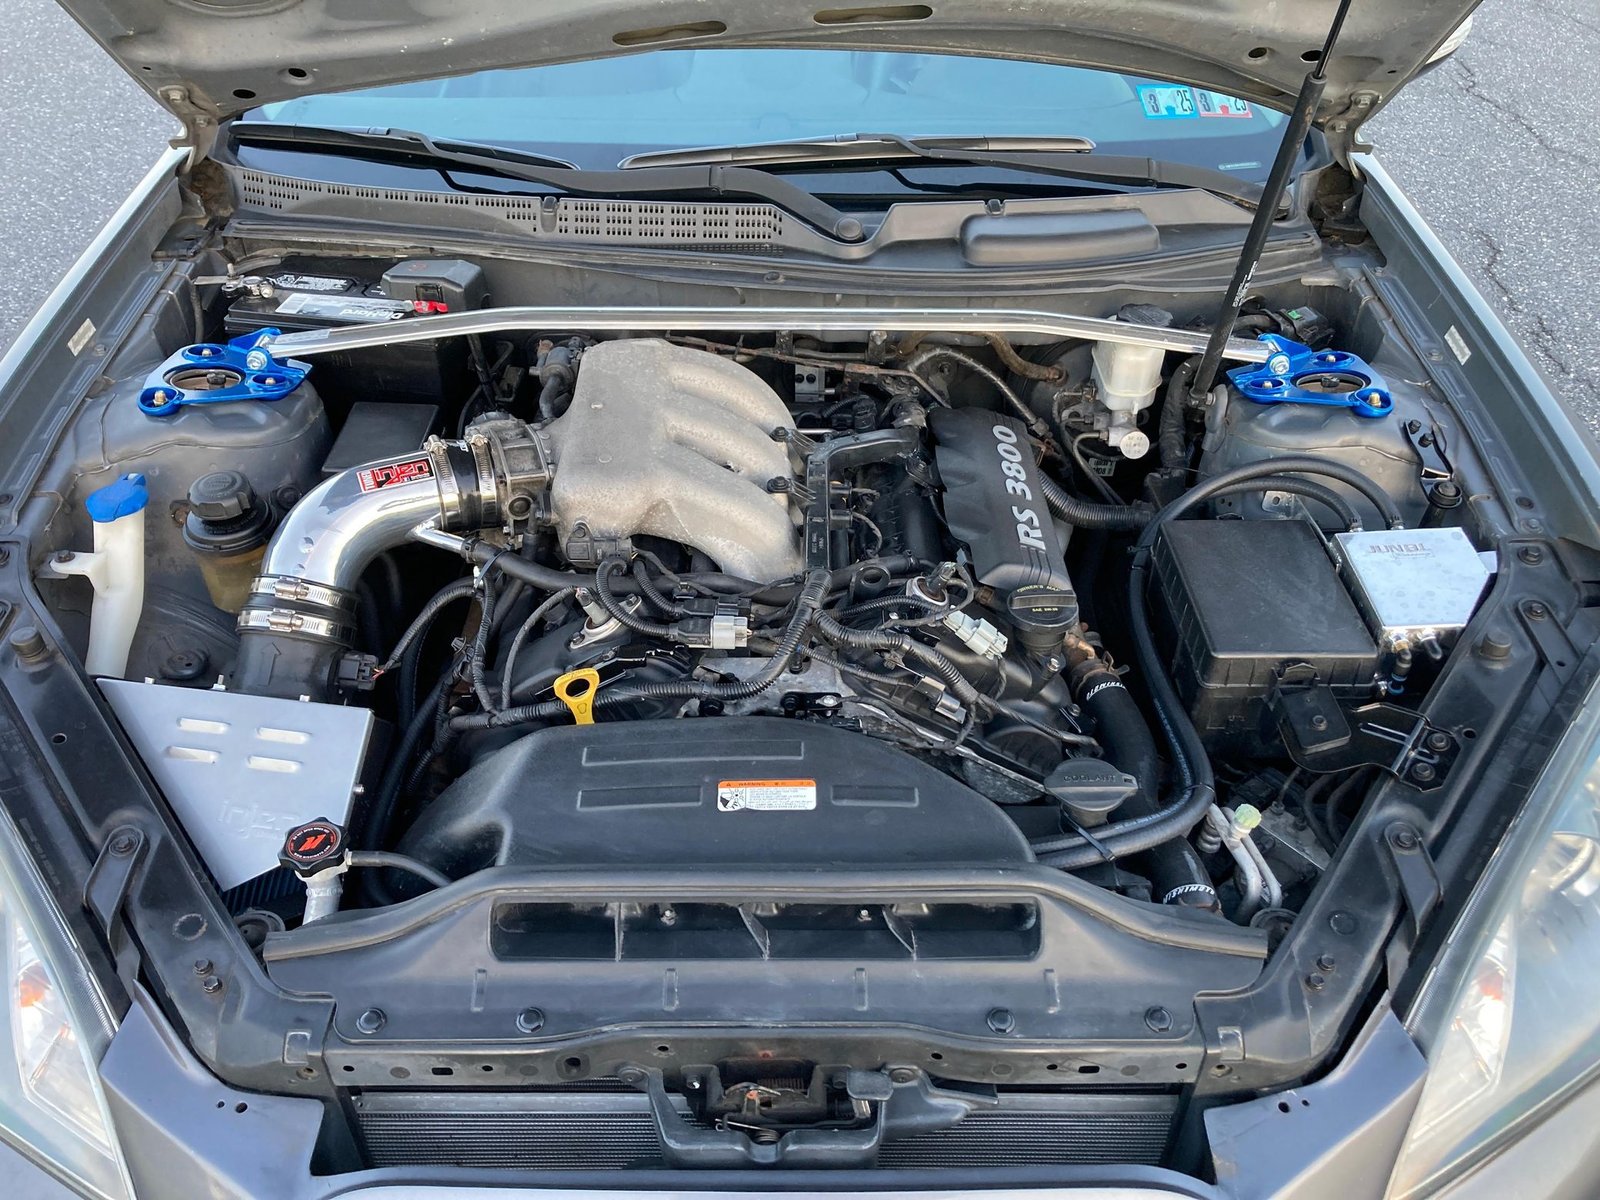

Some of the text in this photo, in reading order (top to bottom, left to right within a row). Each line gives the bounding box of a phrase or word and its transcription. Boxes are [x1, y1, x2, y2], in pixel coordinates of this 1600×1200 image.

[1148, 89, 1194, 114] 3 25
[1199, 92, 1211, 113] 3
[339, 308, 405, 321] DieHard
[374, 460, 430, 488] injen
[992, 424, 1047, 551] RS 3800
[1063, 774, 1117, 784] COOLANT
